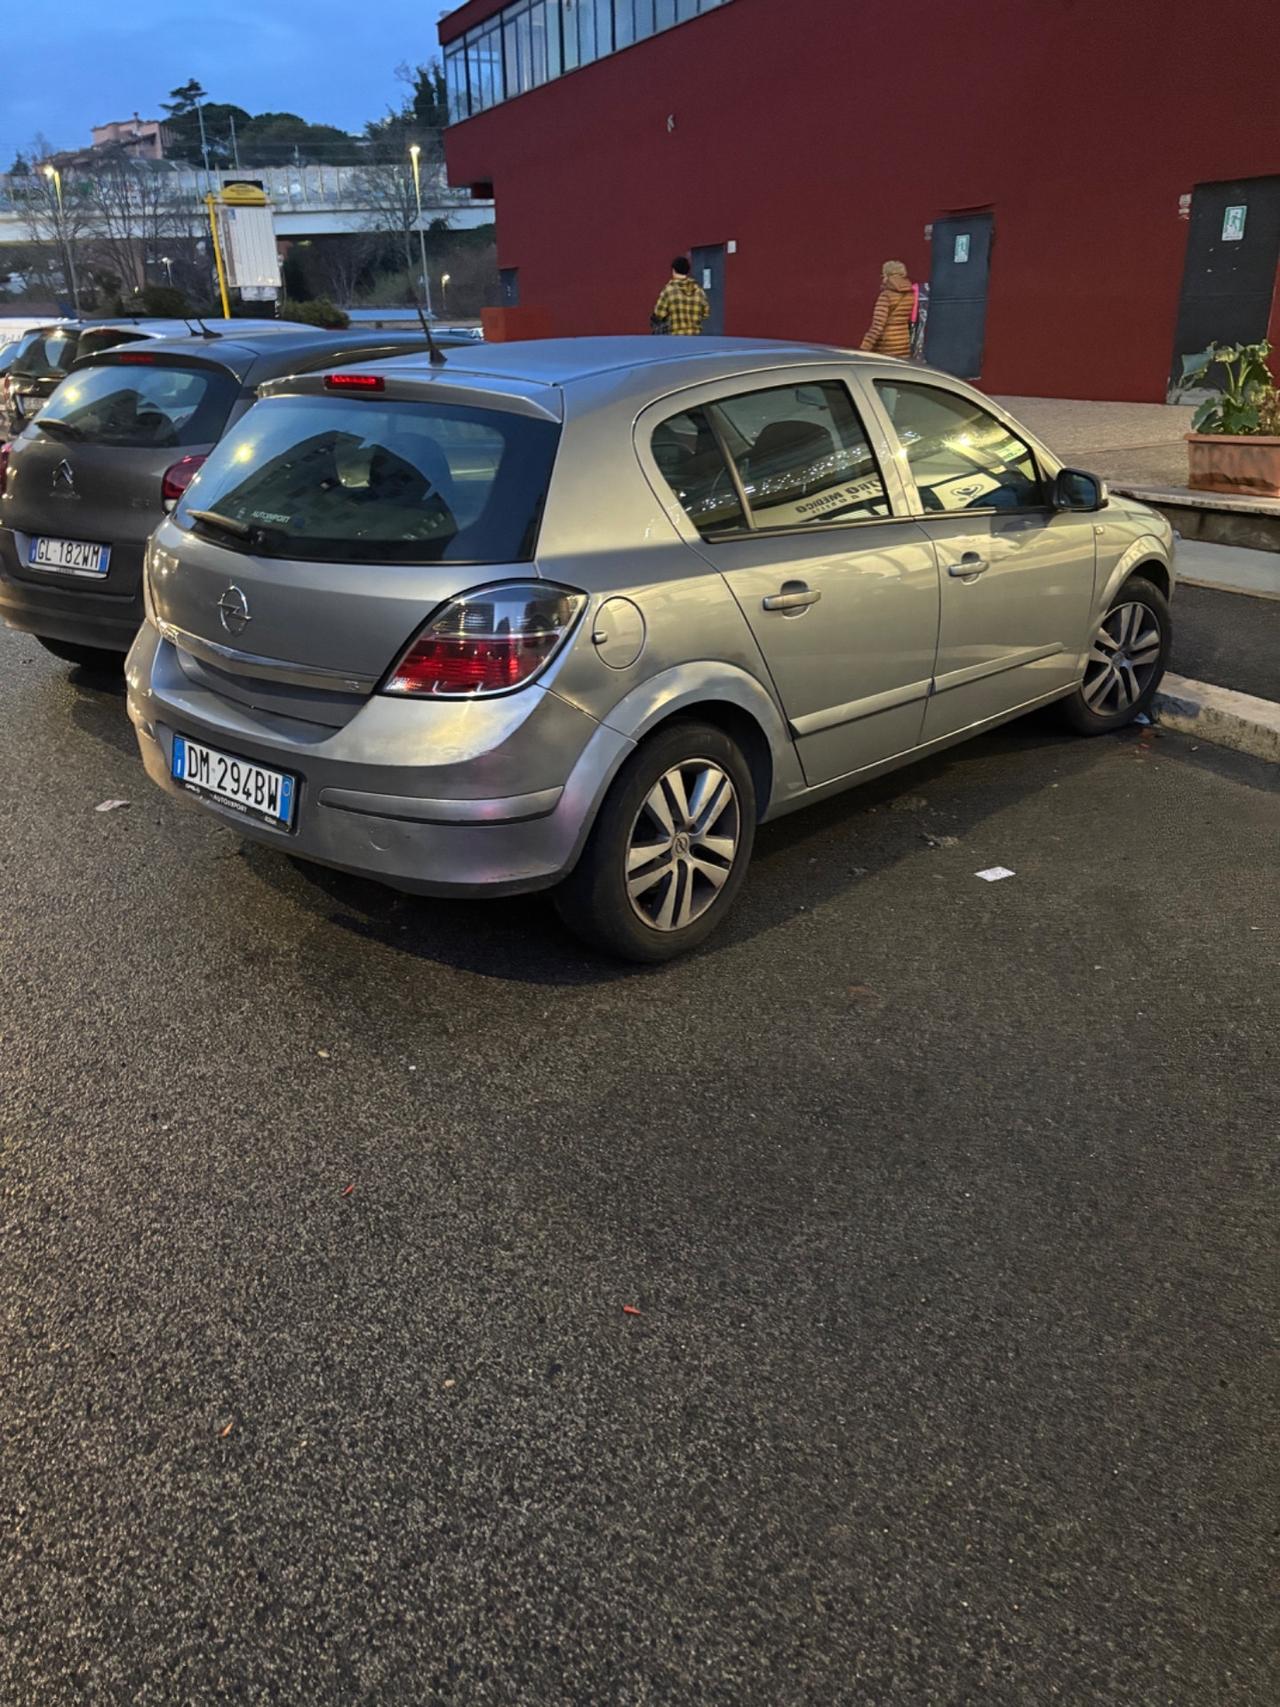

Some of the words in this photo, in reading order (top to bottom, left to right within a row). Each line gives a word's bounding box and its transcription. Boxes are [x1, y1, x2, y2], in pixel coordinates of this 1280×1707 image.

[38, 539, 51, 561] GL
[59, 541, 100, 568] 182WM
[188, 745, 209, 784] DM
[217, 757, 278, 812] 294BW
